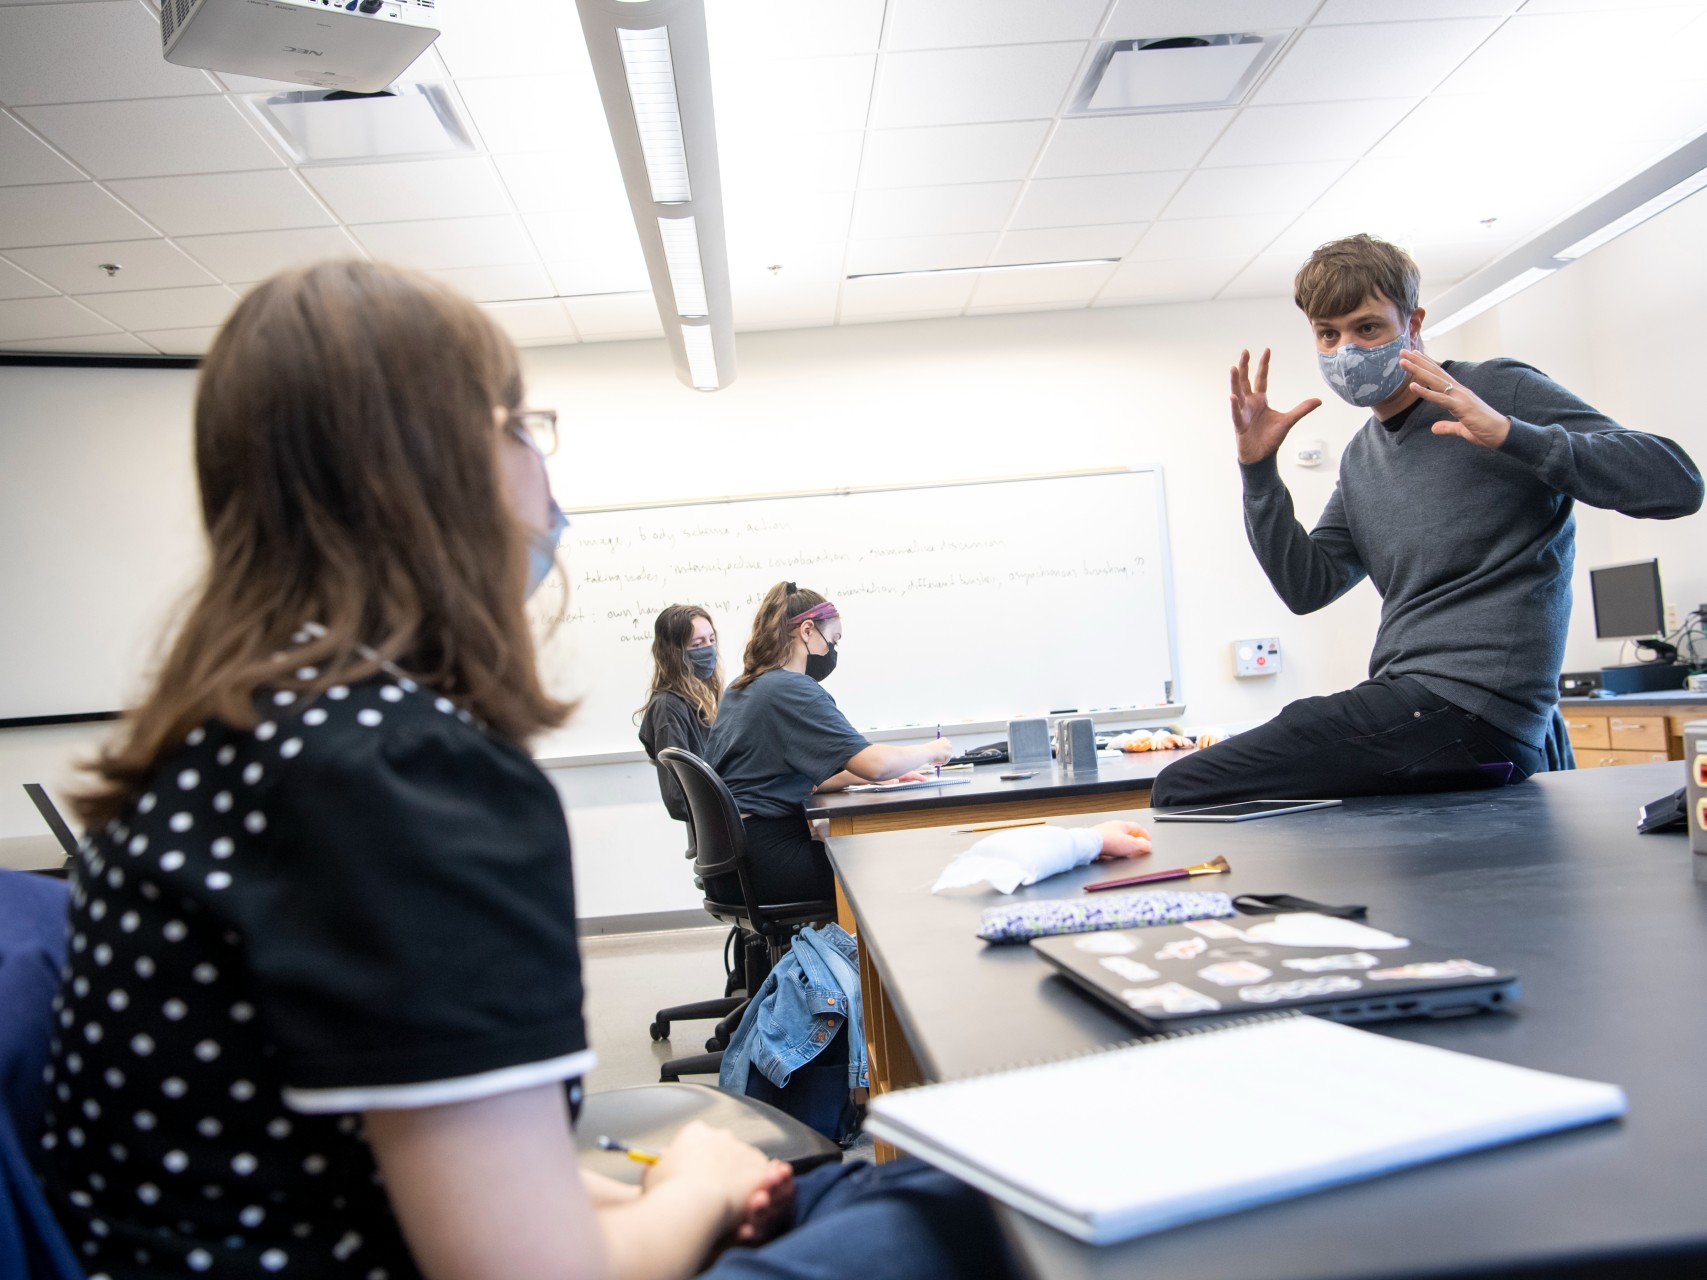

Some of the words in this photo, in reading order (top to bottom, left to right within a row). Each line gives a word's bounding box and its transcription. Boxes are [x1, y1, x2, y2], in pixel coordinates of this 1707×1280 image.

[281, 45, 324, 56] NEC
[638, 526, 676, 549] body
[584, 569, 622, 591] taking
[607, 608, 632, 619] own
[907, 573, 956, 590] different
